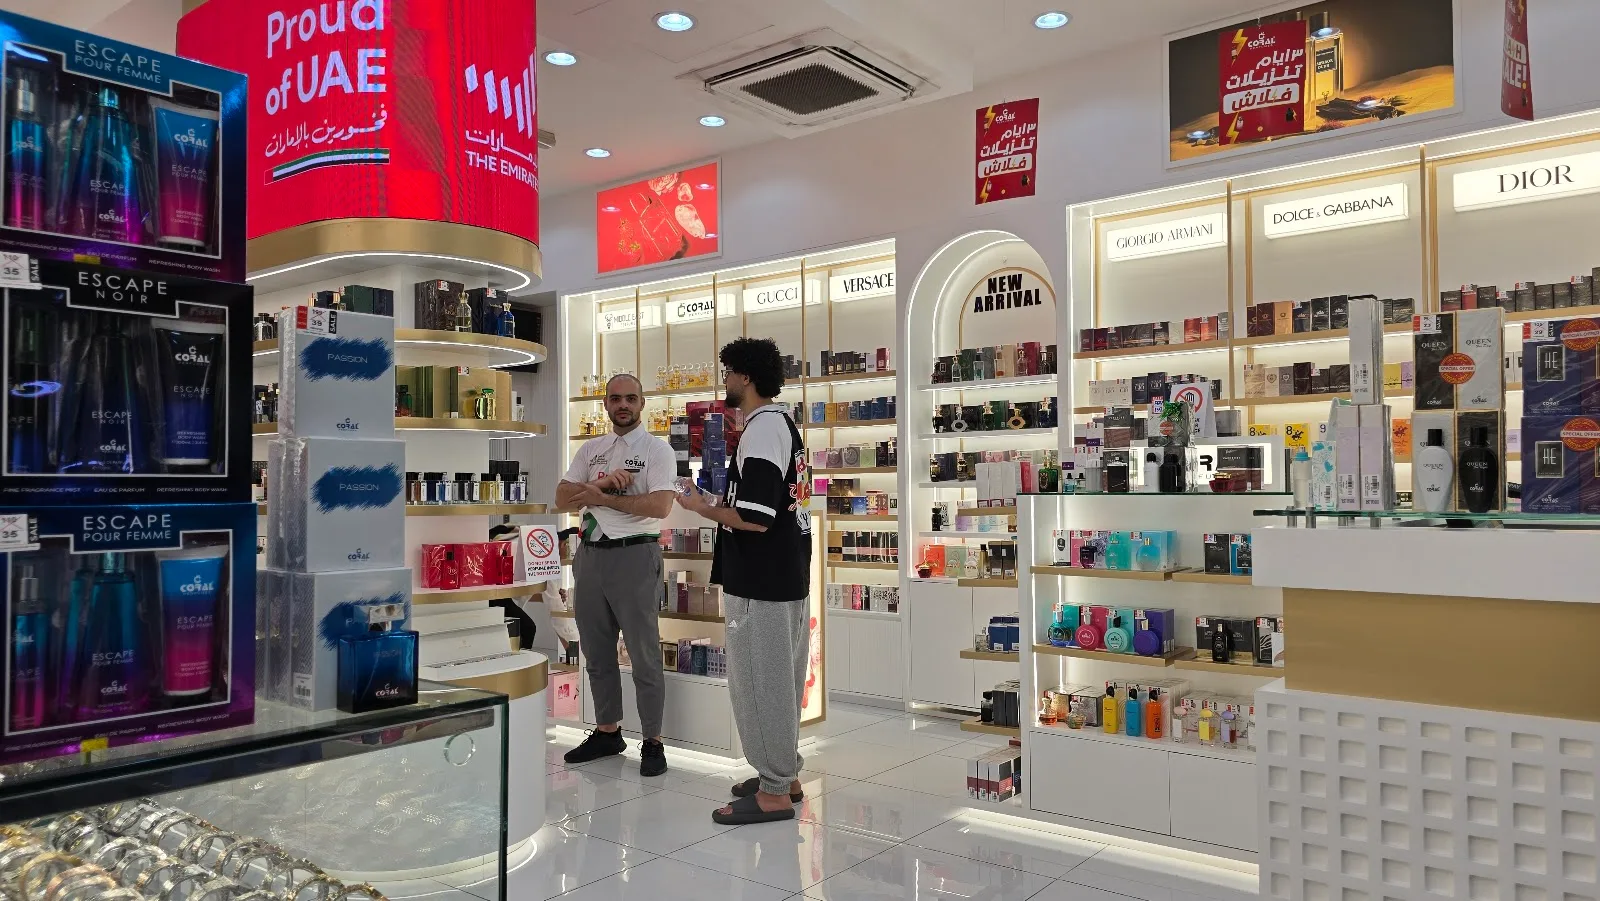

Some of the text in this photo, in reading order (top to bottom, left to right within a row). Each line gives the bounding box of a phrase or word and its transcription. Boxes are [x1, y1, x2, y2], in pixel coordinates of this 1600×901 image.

[1248, 37, 1276, 48] CORAL
[75, 39, 161, 73] ESCAPE
[75, 55, 162, 84] POUR FEMME
[265, 47, 387, 116] of UAE
[1226, 63, 1304, 90] تنزيلات
[1231, 87, 1293, 112] فلاش
[995, 112, 1016, 122] CORAL
[174, 133, 208, 148] CORAL
[980, 136, 1036, 158] تنزيلات
[466, 149, 497, 173] THE
[983, 156, 1027, 176] فلاش
[172, 164, 207, 177] ESCAPE
[1496, 164, 1575, 194] DIOR
[1272, 207, 1315, 226] DOLCE
[1322, 194, 1394, 219] GABBANA
[99, 213, 125, 223] CORAL
[1115, 222, 1214, 251] GIORGIO ARMANI
[111, 254, 138, 262] PARFUM
[148, 258, 186, 269] REFRESHING
[4, 267, 20, 276] 35
[30, 258, 40, 282] SALE
[78, 271, 168, 296] ESCAPE
[843, 272, 894, 295] VERSACE
[987, 273, 1023, 294] NEW
[96, 289, 149, 304] NOIR
[756, 287, 799, 306] GUCCI
[973, 288, 1042, 313] ARRIVAL
[686, 300, 715, 313] CORAL
[311, 319, 323, 327] 39
[1421, 341, 1447, 349] QUEEN
[1466, 338, 1492, 346] QUEEN
[175, 352, 211, 365] CORAL
[327, 353, 369, 365] PASSION
[1544, 351, 1559, 369] HE
[173, 385, 211, 395] ESCAPE
[91, 410, 133, 420] ESCAPE
[336, 422, 360, 431] CORAL
[1249, 427, 1257, 436] 8
[1286, 425, 1293, 436] 8
[1319, 423, 1327, 433] 9
[99, 443, 127, 452] CORAL
[1542, 447, 1557, 465] HE
[625, 458, 646, 468] CORAL
[339, 482, 380, 492] PASSION
[83, 513, 172, 531] ESCAPE
[2, 530, 18, 539] 35
[29, 517, 38, 542] SALE
[83, 530, 172, 542] POUR FEMME
[348, 551, 371, 560] CORAL
[180, 582, 214, 593] CORAL
[177, 615, 213, 624] ESCAPE
[92, 649, 134, 661] ESCAPE
[101, 684, 128, 694] CORAL
[375, 686, 400, 698] CORAL
